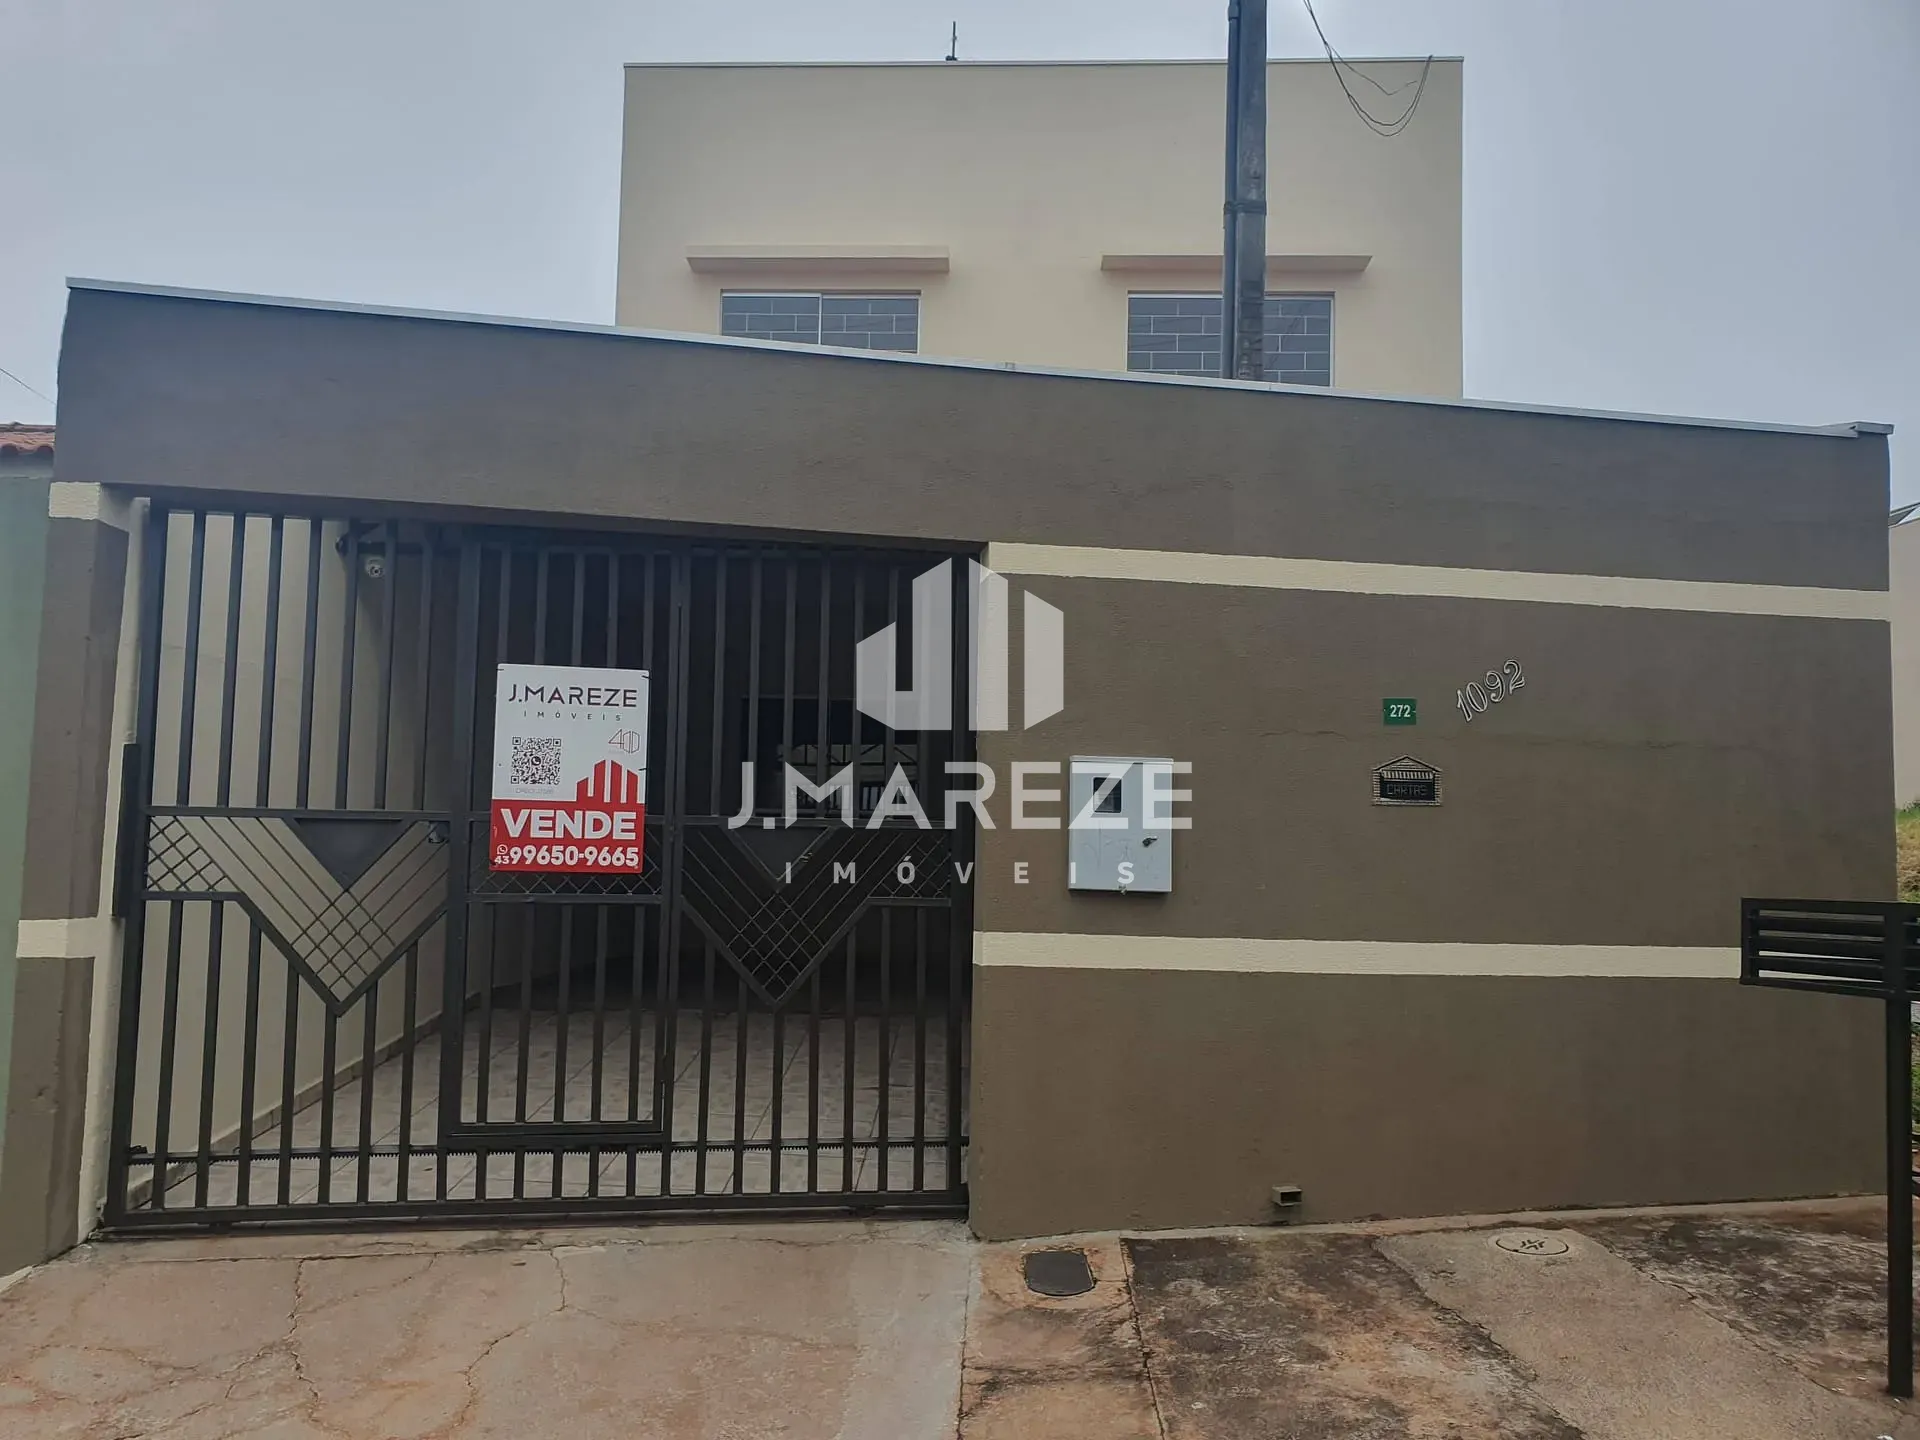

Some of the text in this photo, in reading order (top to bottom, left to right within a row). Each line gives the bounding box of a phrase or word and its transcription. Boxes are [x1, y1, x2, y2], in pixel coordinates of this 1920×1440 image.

[508, 684, 638, 708] J.MAREZE
[1456, 658, 1525, 723] 1092
[1389, 704, 1411, 718] 272
[500, 808, 637, 840] VENDE
[494, 844, 640, 867] 43 99650-9665
